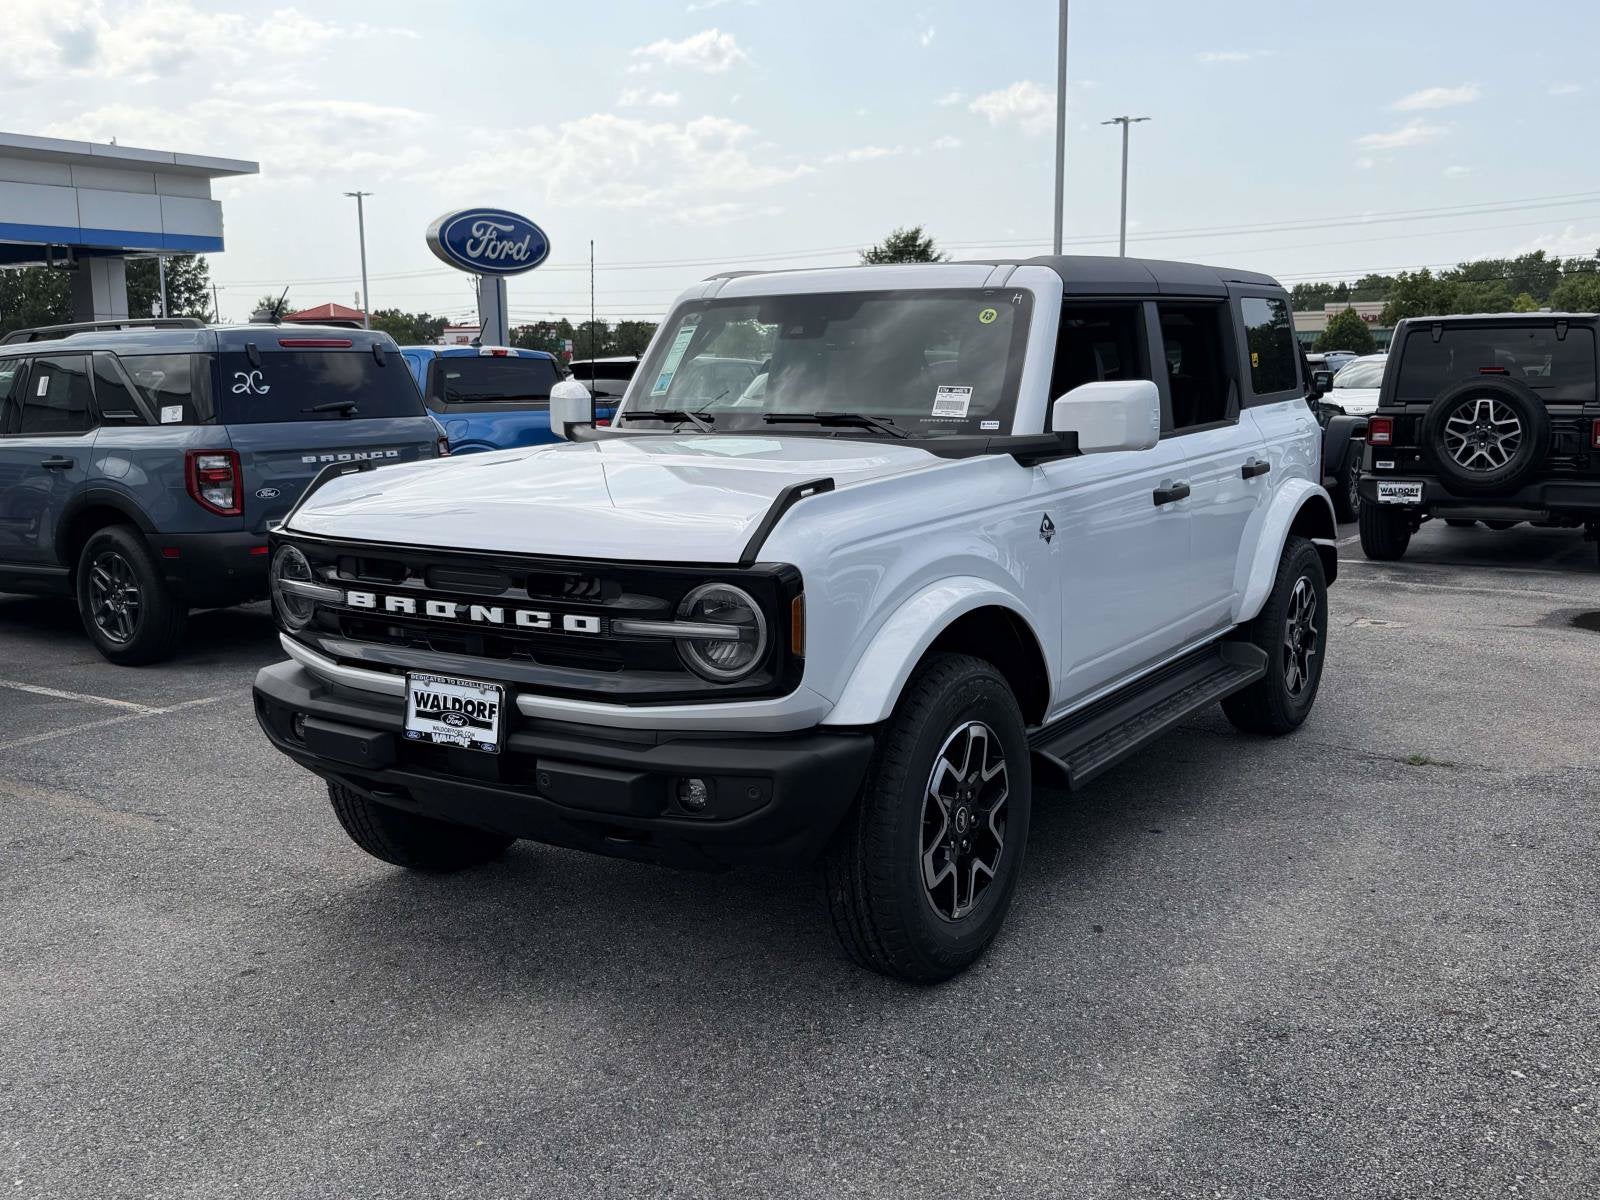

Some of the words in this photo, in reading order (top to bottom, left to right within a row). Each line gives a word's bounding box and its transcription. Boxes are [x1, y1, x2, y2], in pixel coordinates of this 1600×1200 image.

[466, 220, 531, 261] Ford
[302, 450, 399, 464] BRONCO
[258, 488, 277, 498] Ford
[347, 590, 601, 633] BRONCO
[413, 691, 498, 720] WALDORF
[431, 732, 471, 748] WALDORF
